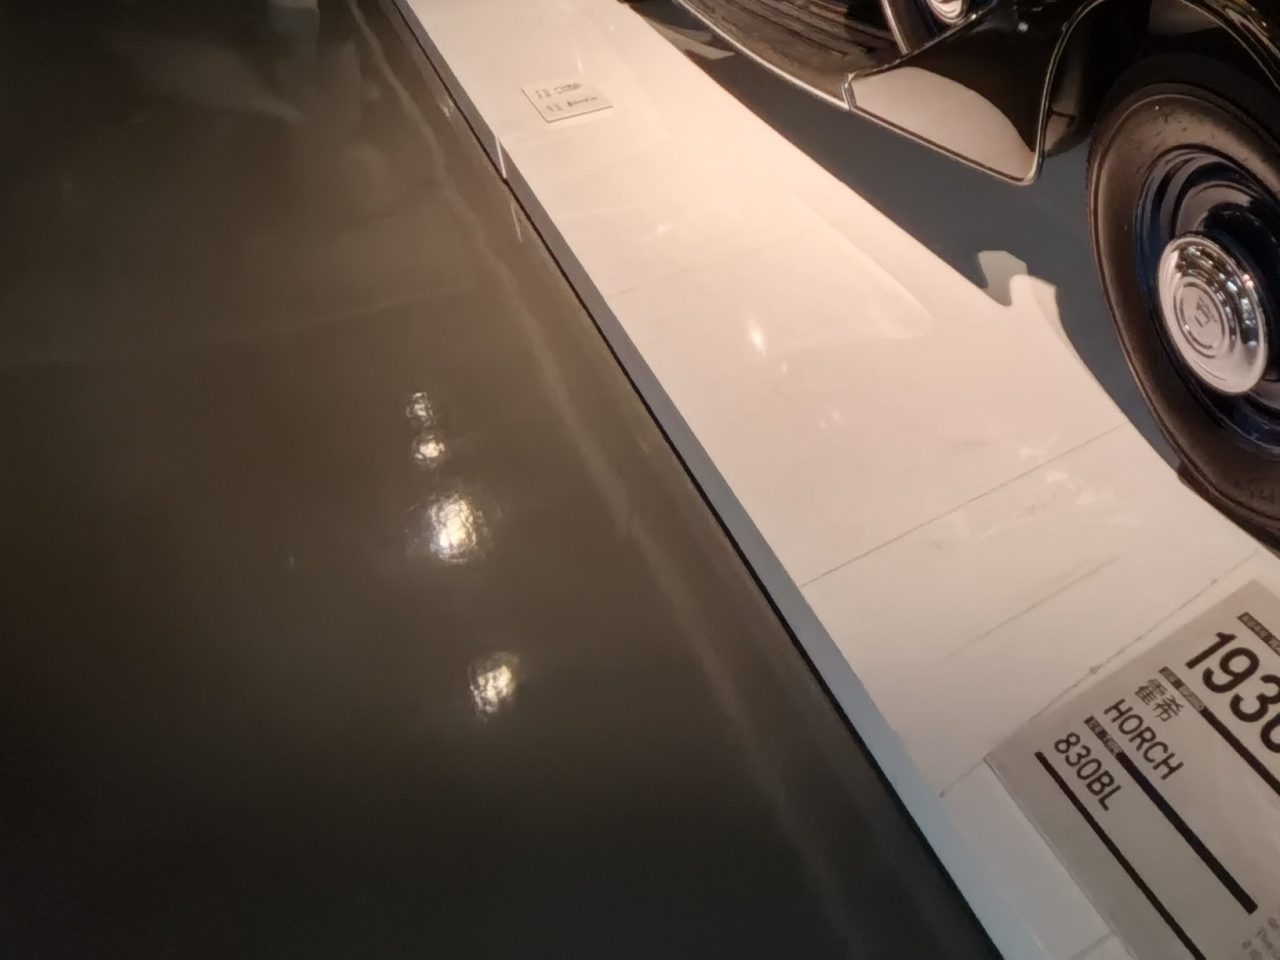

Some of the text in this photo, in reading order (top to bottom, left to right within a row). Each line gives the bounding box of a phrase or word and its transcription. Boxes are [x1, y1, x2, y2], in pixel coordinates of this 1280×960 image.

[1103, 697, 1185, 781] HORCH
[1133, 677, 1185, 723] 霍希
[1053, 731, 1123, 812] 830BL
